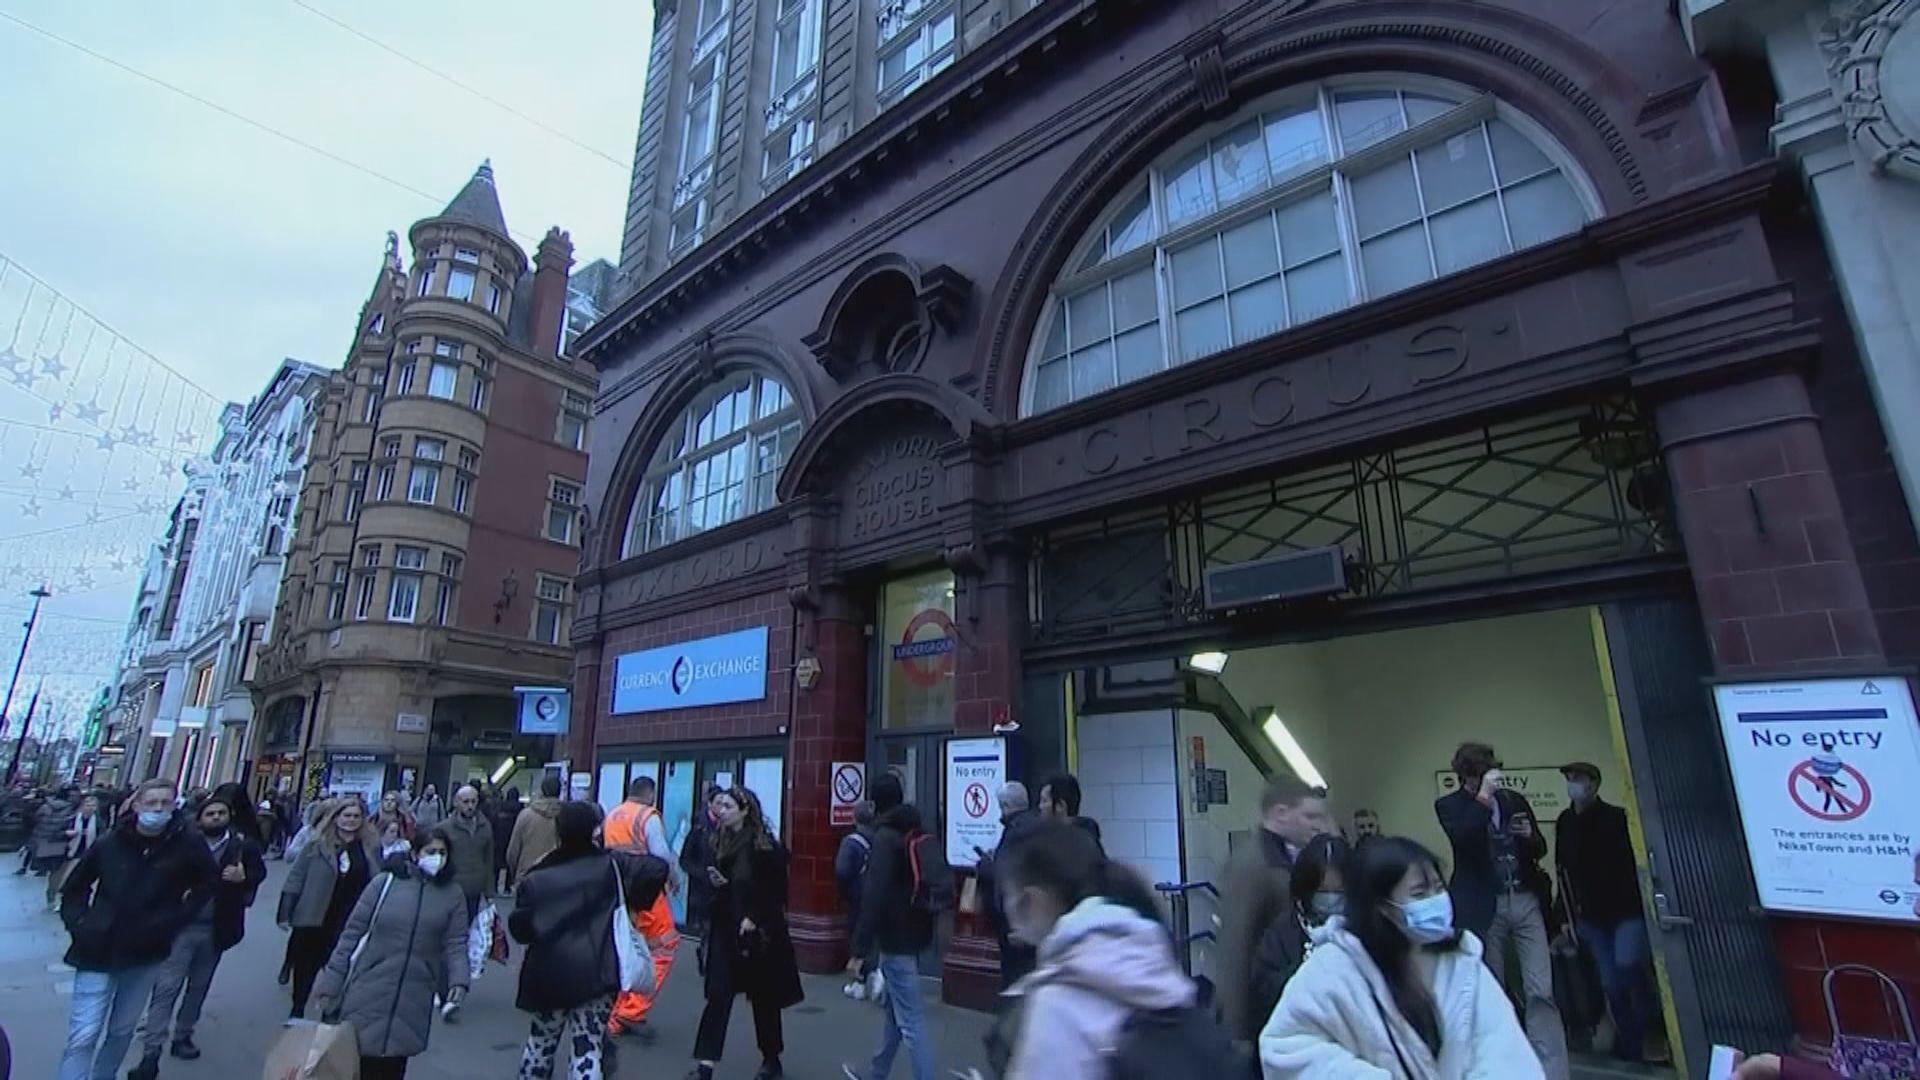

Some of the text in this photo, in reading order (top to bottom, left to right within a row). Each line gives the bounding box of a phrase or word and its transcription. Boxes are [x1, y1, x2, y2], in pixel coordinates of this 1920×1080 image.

[1080, 325, 1470, 475] CIRCUS
[855, 465, 935, 509] CIRCUS
[852, 495, 935, 538] HOUSE
[627, 538, 764, 605] OXFORD
[895, 639, 954, 657] UNDERGROU
[620, 672, 671, 690] CURRENCY
[695, 656, 761, 680] EXCHANGE
[1751, 729, 1883, 749] No entry
[955, 766, 997, 779] No entry
[1495, 775, 1530, 789] ntry
[1770, 828, 1911, 845] The entrances are by
[1847, 844, 1873, 855] and
[1875, 845, 1911, 857] H&M
